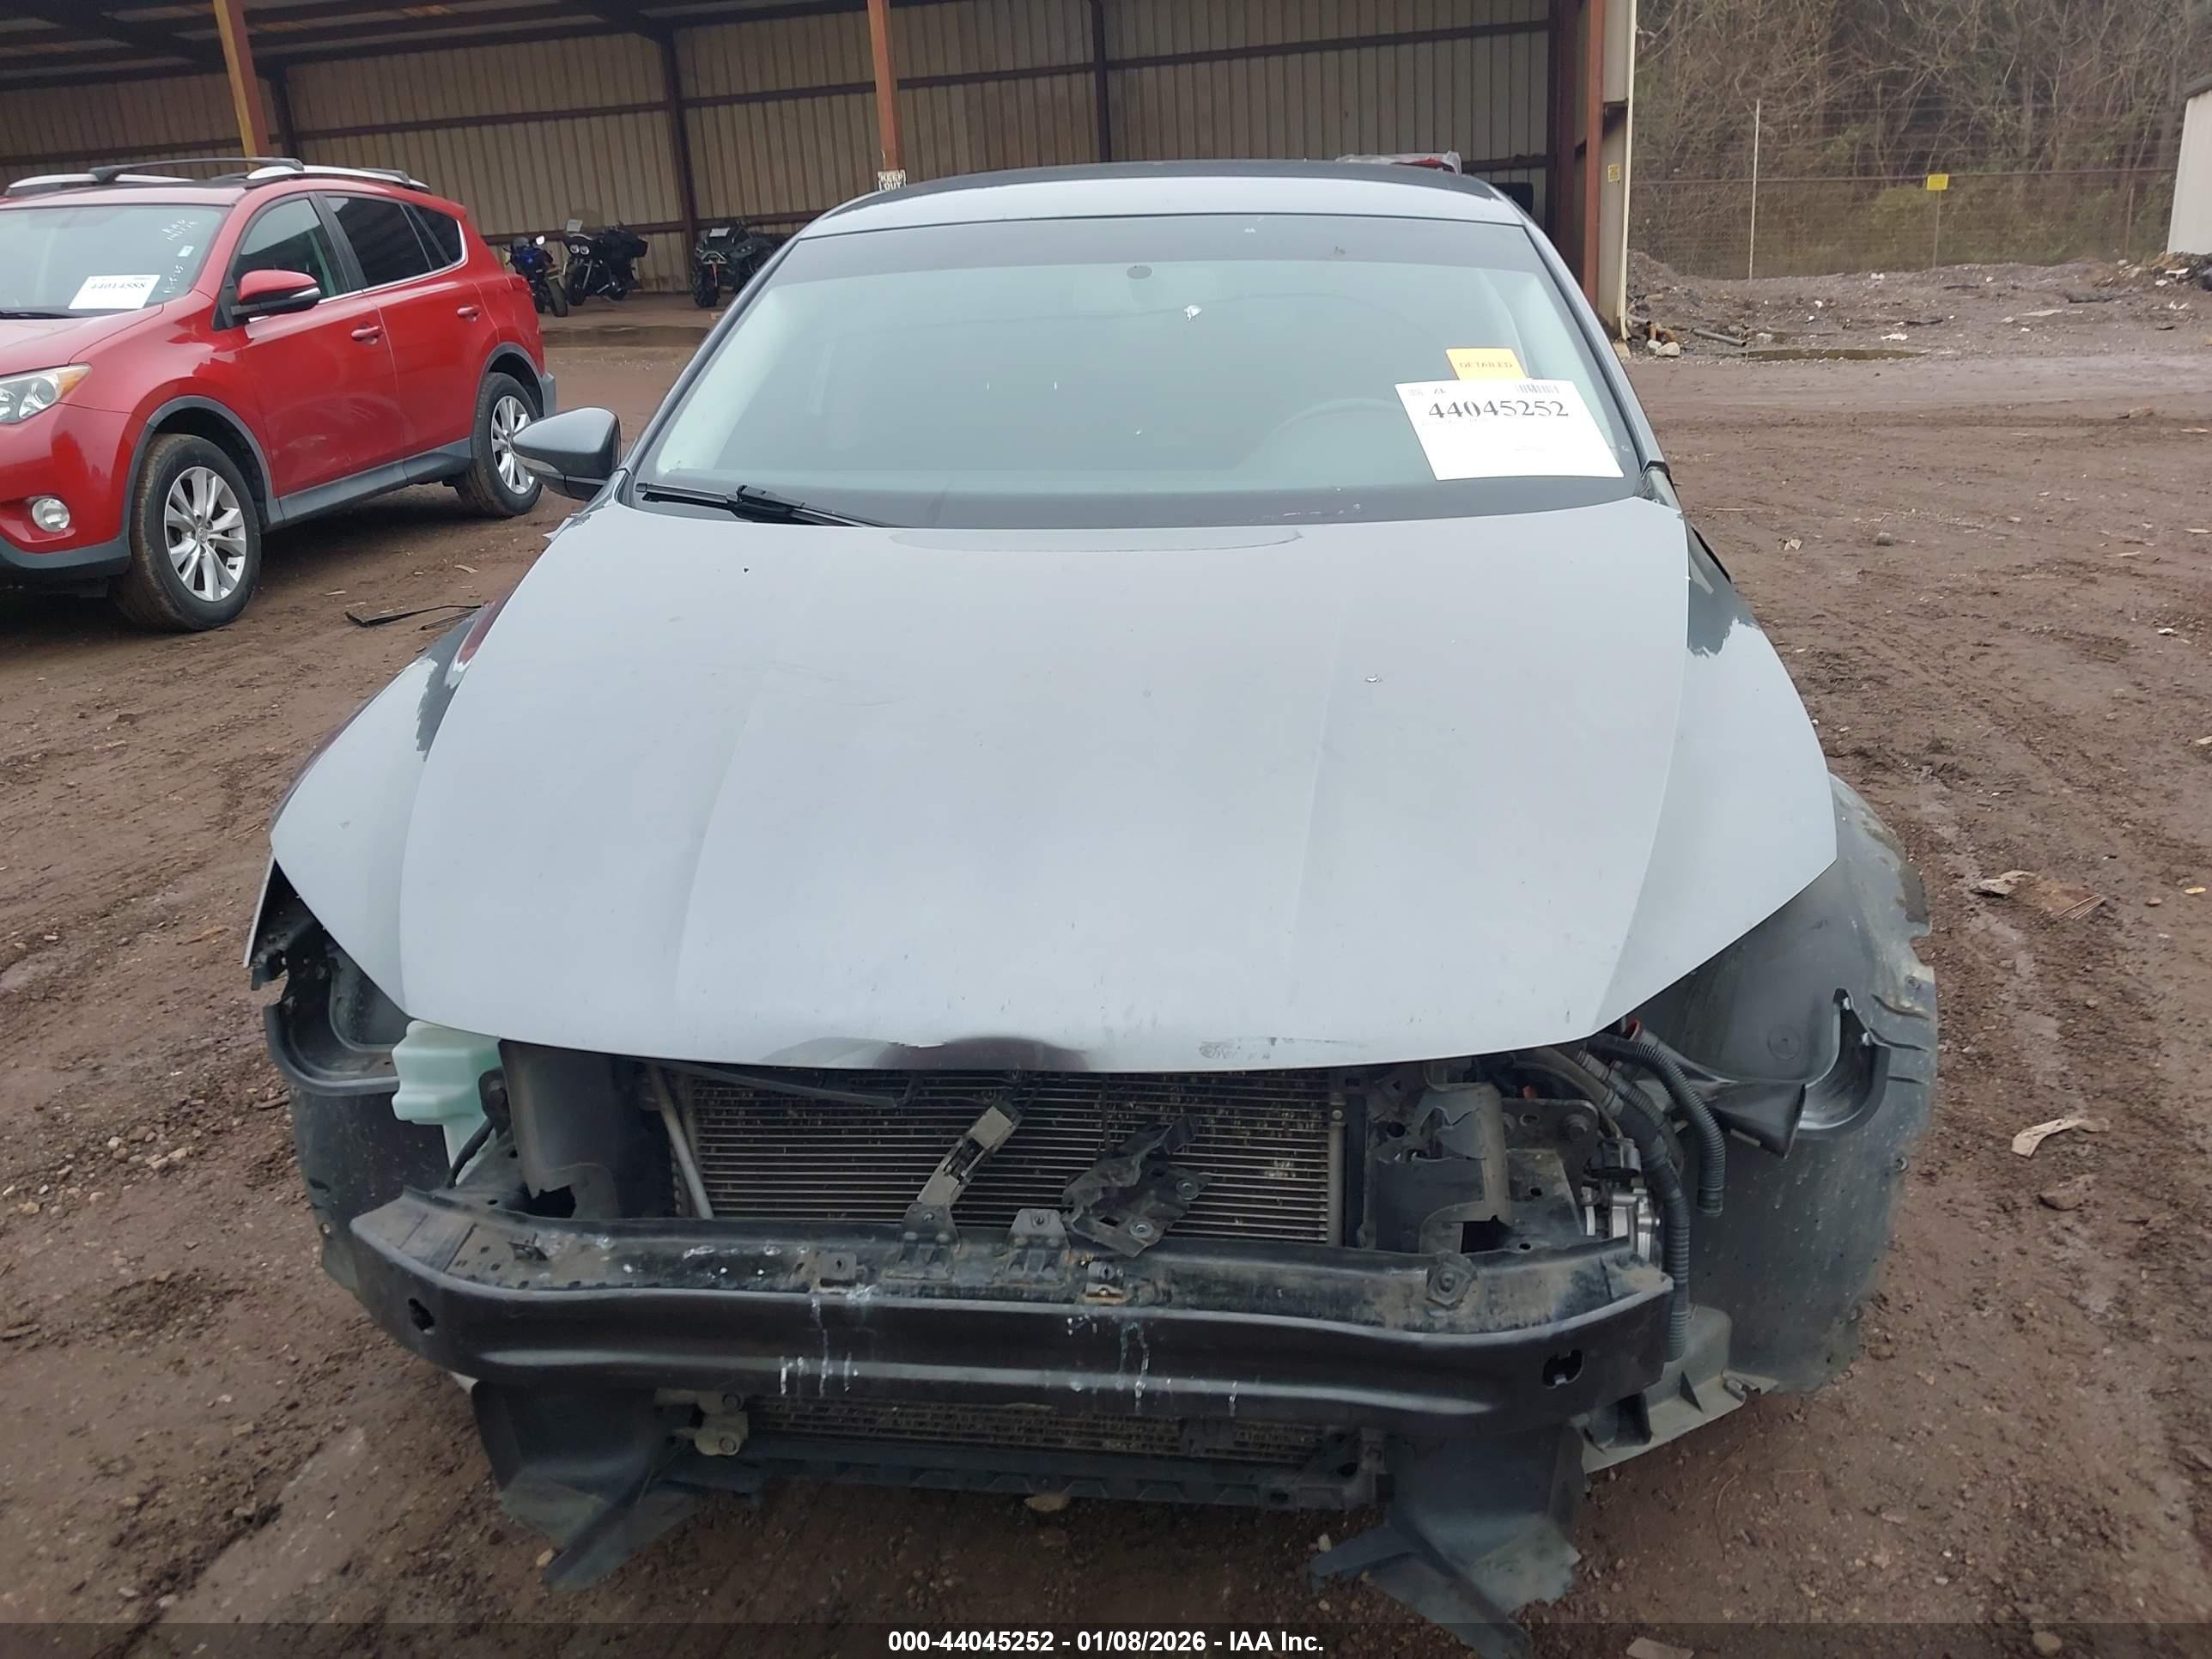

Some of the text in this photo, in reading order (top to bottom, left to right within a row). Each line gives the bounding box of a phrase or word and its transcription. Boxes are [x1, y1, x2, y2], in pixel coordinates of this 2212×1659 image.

[880, 172, 902, 181] KEEP
[884, 181, 902, 191] OUT
[1428, 399, 1570, 419] 44045252
